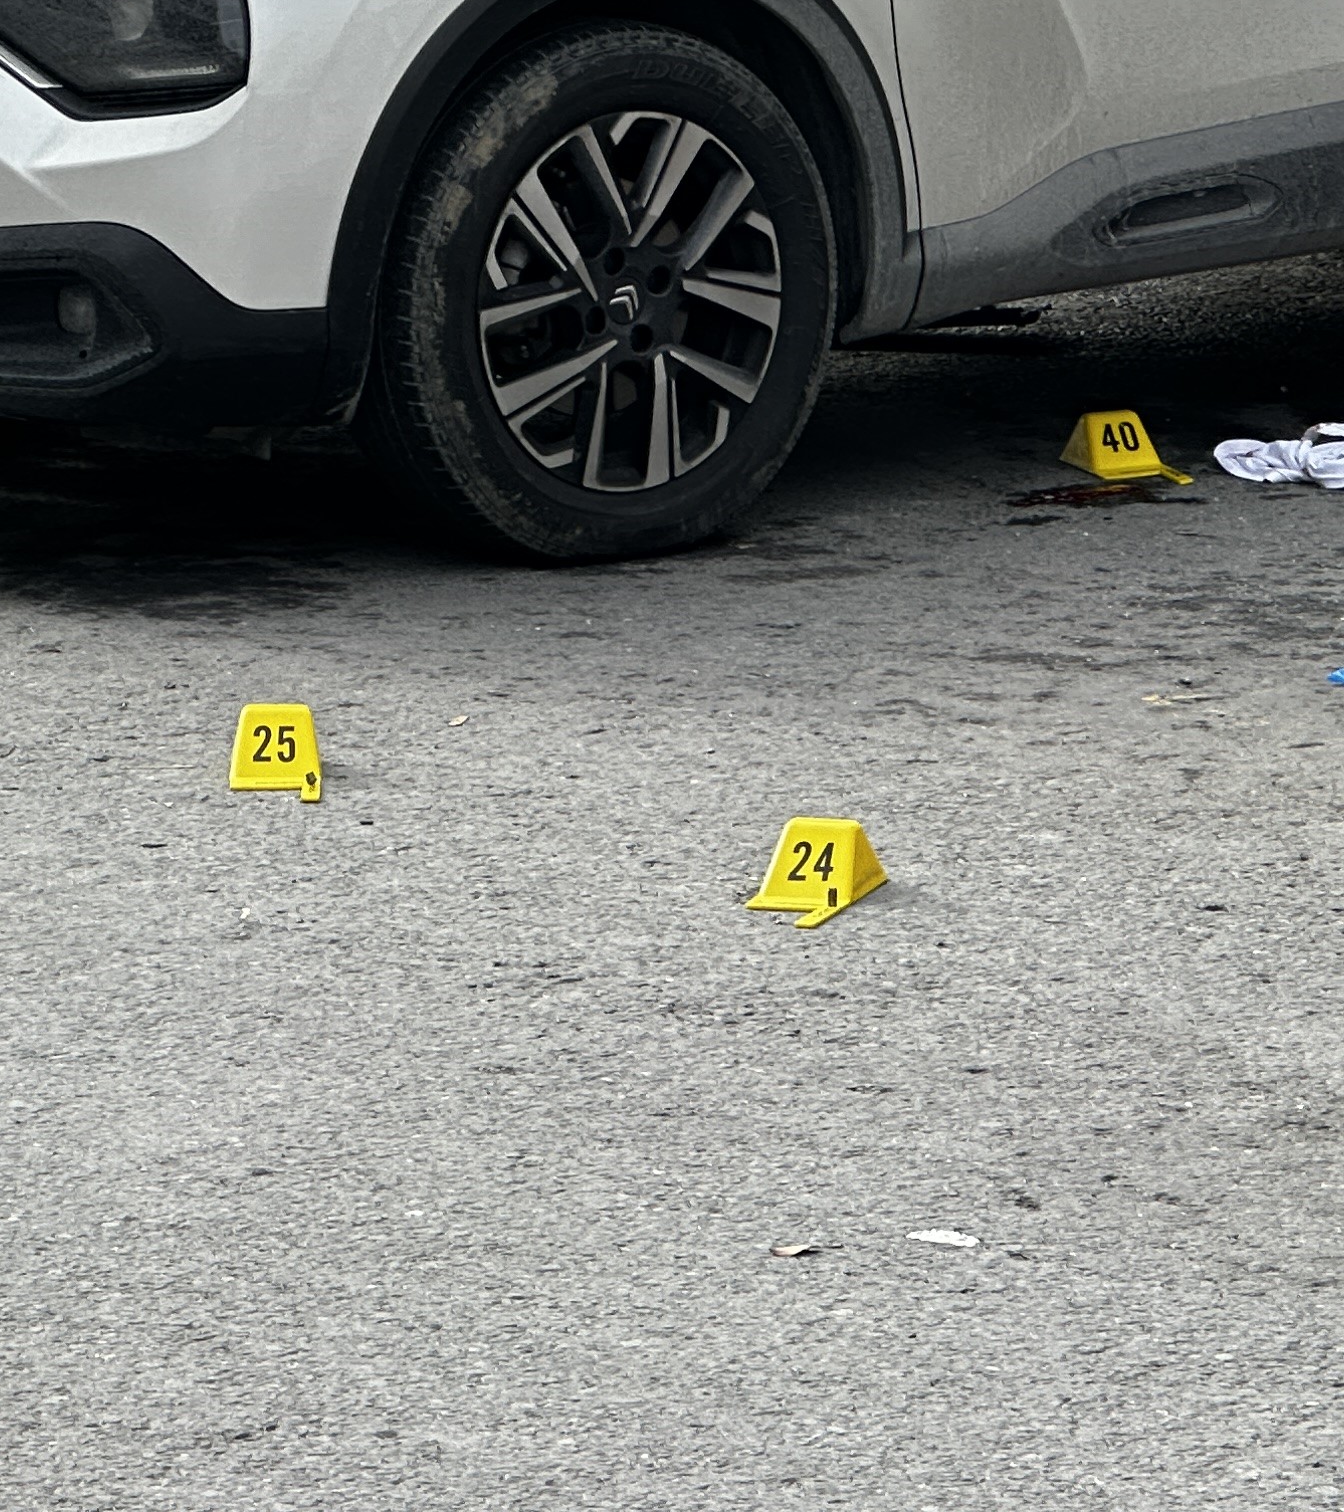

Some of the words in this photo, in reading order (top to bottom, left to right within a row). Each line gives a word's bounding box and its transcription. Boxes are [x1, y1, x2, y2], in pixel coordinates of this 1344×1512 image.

[1102, 421, 1140, 453] 40
[252, 725, 296, 763] 25
[787, 841, 835, 882] 24
